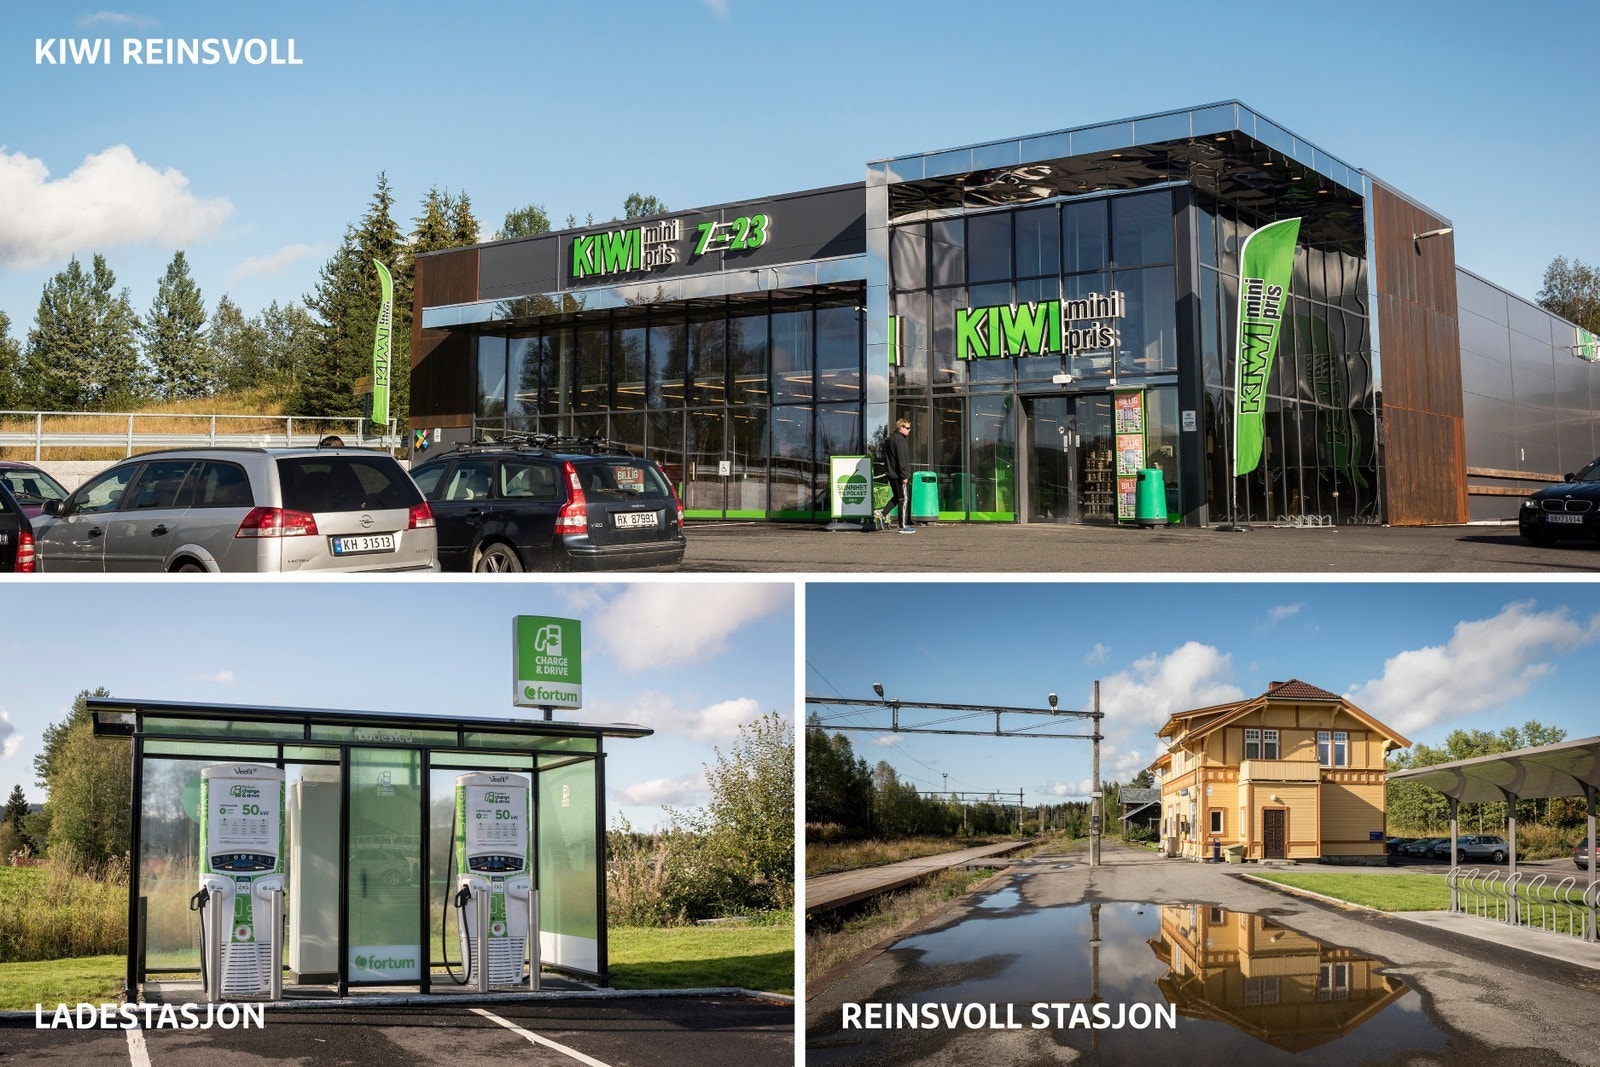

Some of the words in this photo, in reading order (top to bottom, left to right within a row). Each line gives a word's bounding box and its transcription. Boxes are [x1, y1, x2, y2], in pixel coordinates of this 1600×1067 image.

[643, 219, 679, 243] mini
[694, 213, 769, 255] 7-23
[572, 228, 644, 279] KIWI
[644, 243, 676, 271] pris
[1065, 290, 1124, 319] mini
[1244, 278, 1264, 317] mini
[1261, 284, 1282, 320] pris
[955, 298, 1063, 361] KIWI
[1065, 321, 1120, 355] pris
[376, 326, 389, 387] KIWI
[1240, 321, 1274, 414] KIWI
[617, 469, 639, 480] BILLIG
[617, 515, 628, 525] AX
[630, 513, 655, 524] 87991
[343, 539, 358, 550] KH
[363, 536, 391, 549] 31513
[535, 656, 568, 667] CHARGE
[535, 665, 543, 674] &
[544, 666, 568, 676] DRIVE
[537, 686, 578, 702] fortum
[242, 804, 260, 815] 50
[495, 809, 510, 820] 50
[368, 954, 415, 970] fortum
